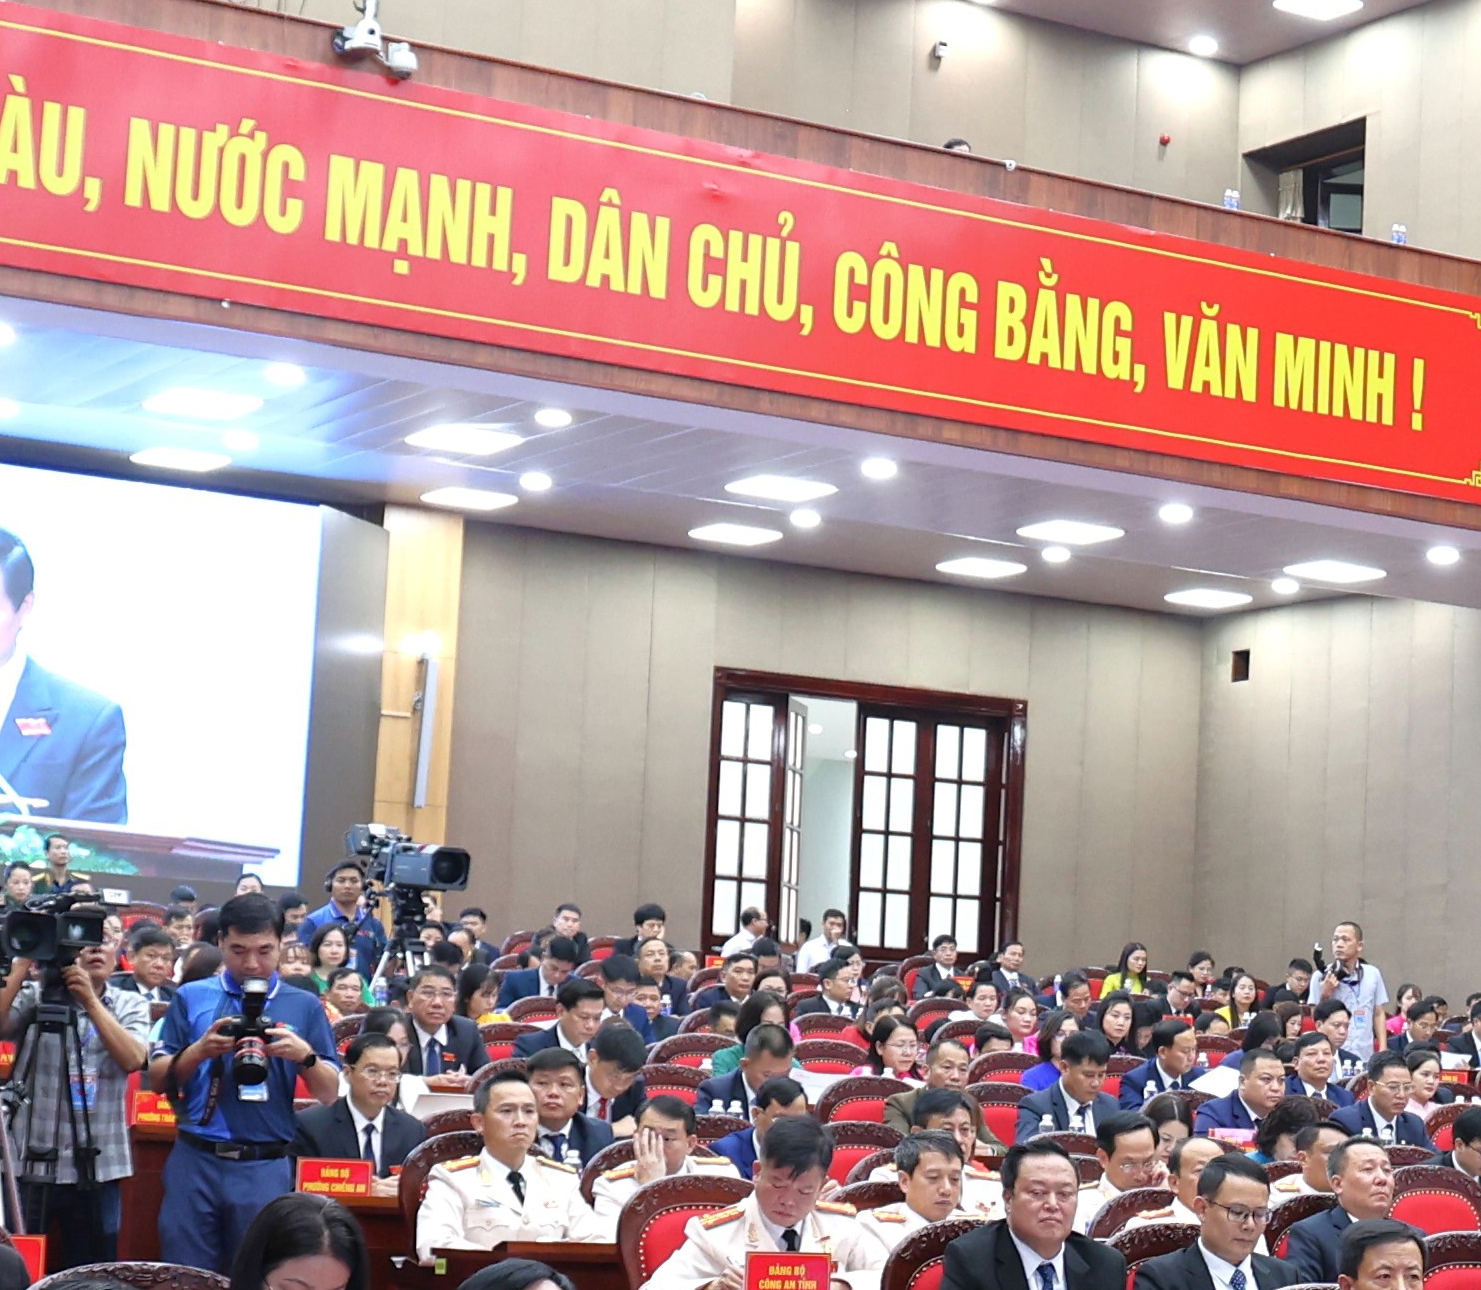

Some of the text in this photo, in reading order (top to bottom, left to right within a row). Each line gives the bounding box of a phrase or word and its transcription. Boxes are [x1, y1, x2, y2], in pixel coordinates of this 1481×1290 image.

[125, 119, 305, 234] NƯỚC
[324, 155, 527, 284] MẠNH,
[548, 188, 670, 299] DÂN
[688, 211, 814, 336] CHỦ,
[833, 242, 979, 354] CÔNG
[994, 257, 1146, 393] BẰNG,
[1162, 301, 1259, 403] VĂN
[1273, 332, 1396, 426] MINH
[1411, 358, 1425, 431] !
[768, 1262, 806, 1277] ĐẢNG BỘ
[758, 1277, 817, 1290] CÔNG AN TỈNH
